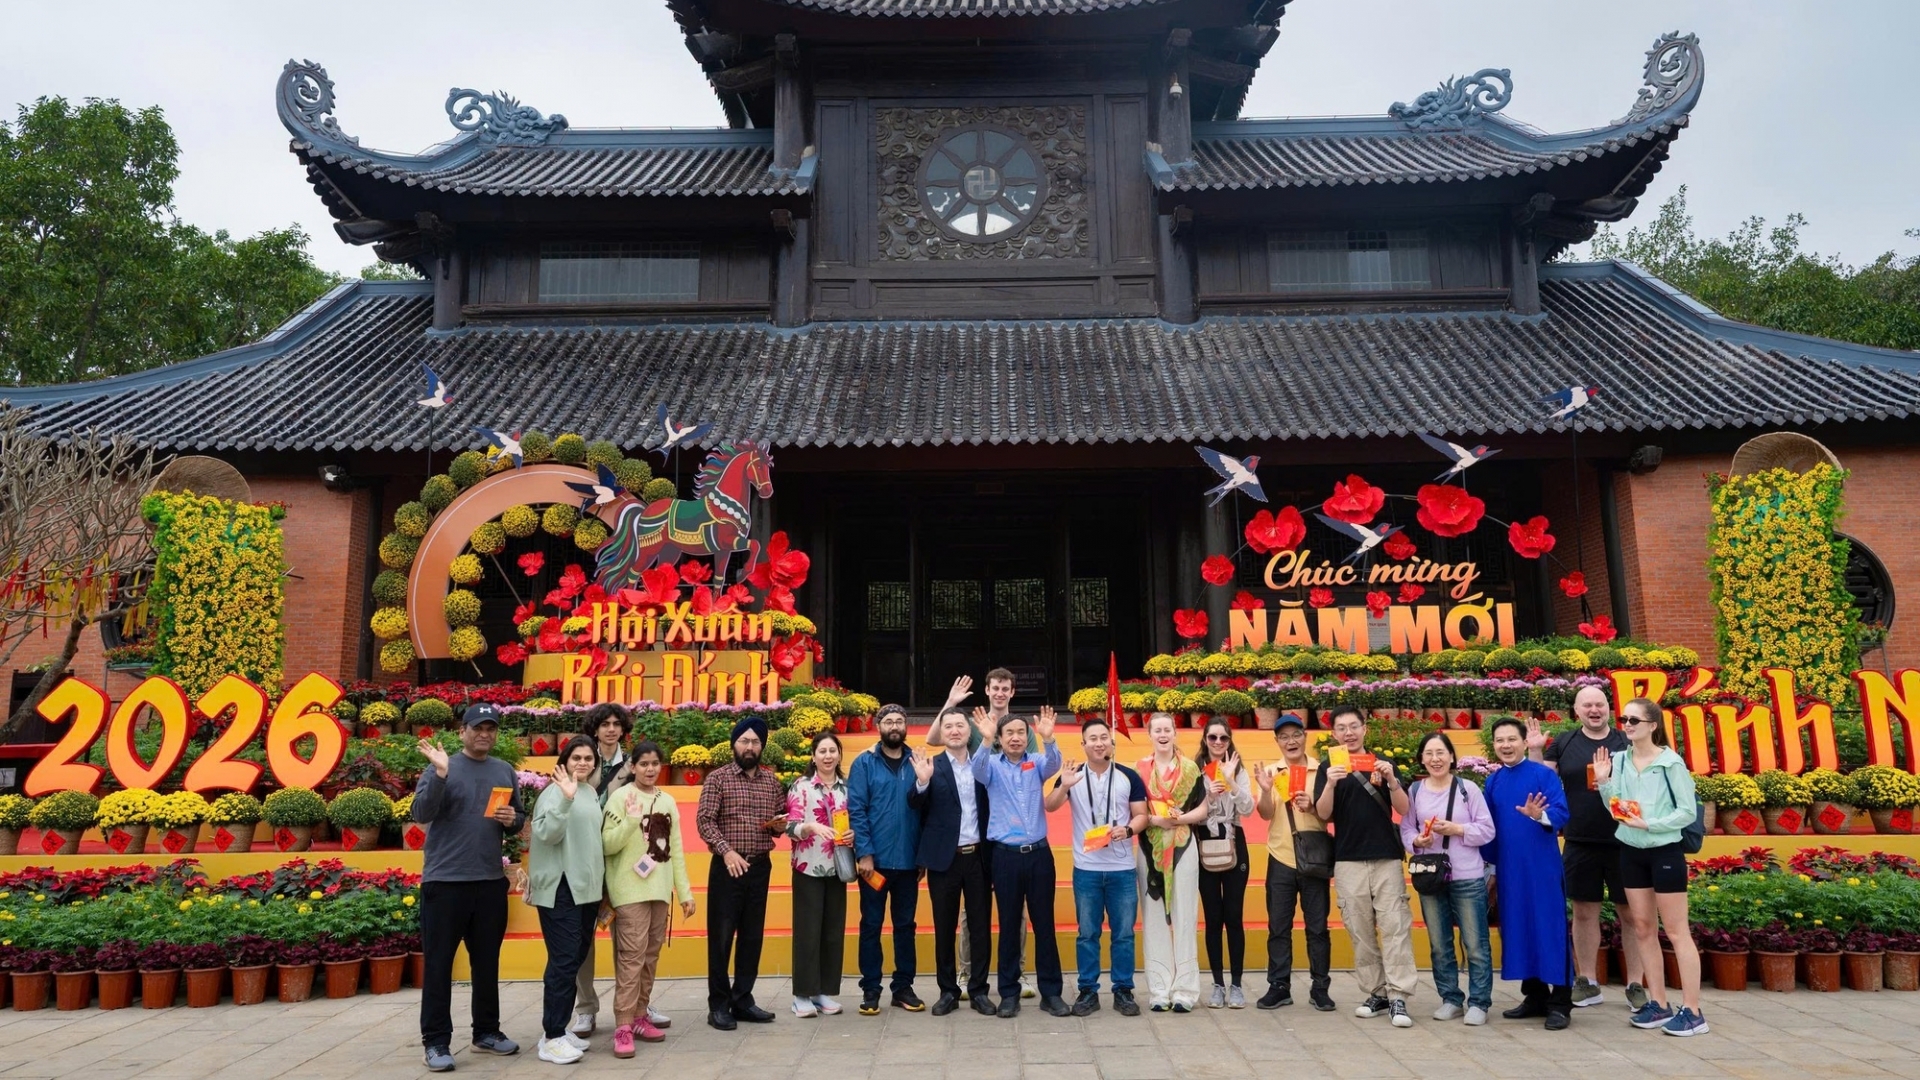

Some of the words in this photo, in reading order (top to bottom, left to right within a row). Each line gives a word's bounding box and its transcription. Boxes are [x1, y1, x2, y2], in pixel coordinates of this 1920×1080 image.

[1263, 549, 1357, 590] Chúc
[1367, 555, 1481, 599] mừng
[591, 601, 657, 650] Hội
[664, 600, 773, 644] Xuân
[1229, 599, 1370, 655] NĂM
[1389, 591, 1515, 654] MỚI
[561, 652, 645, 705] Bái
[657, 651, 781, 712] Đính
[24, 671, 347, 798] 2026
